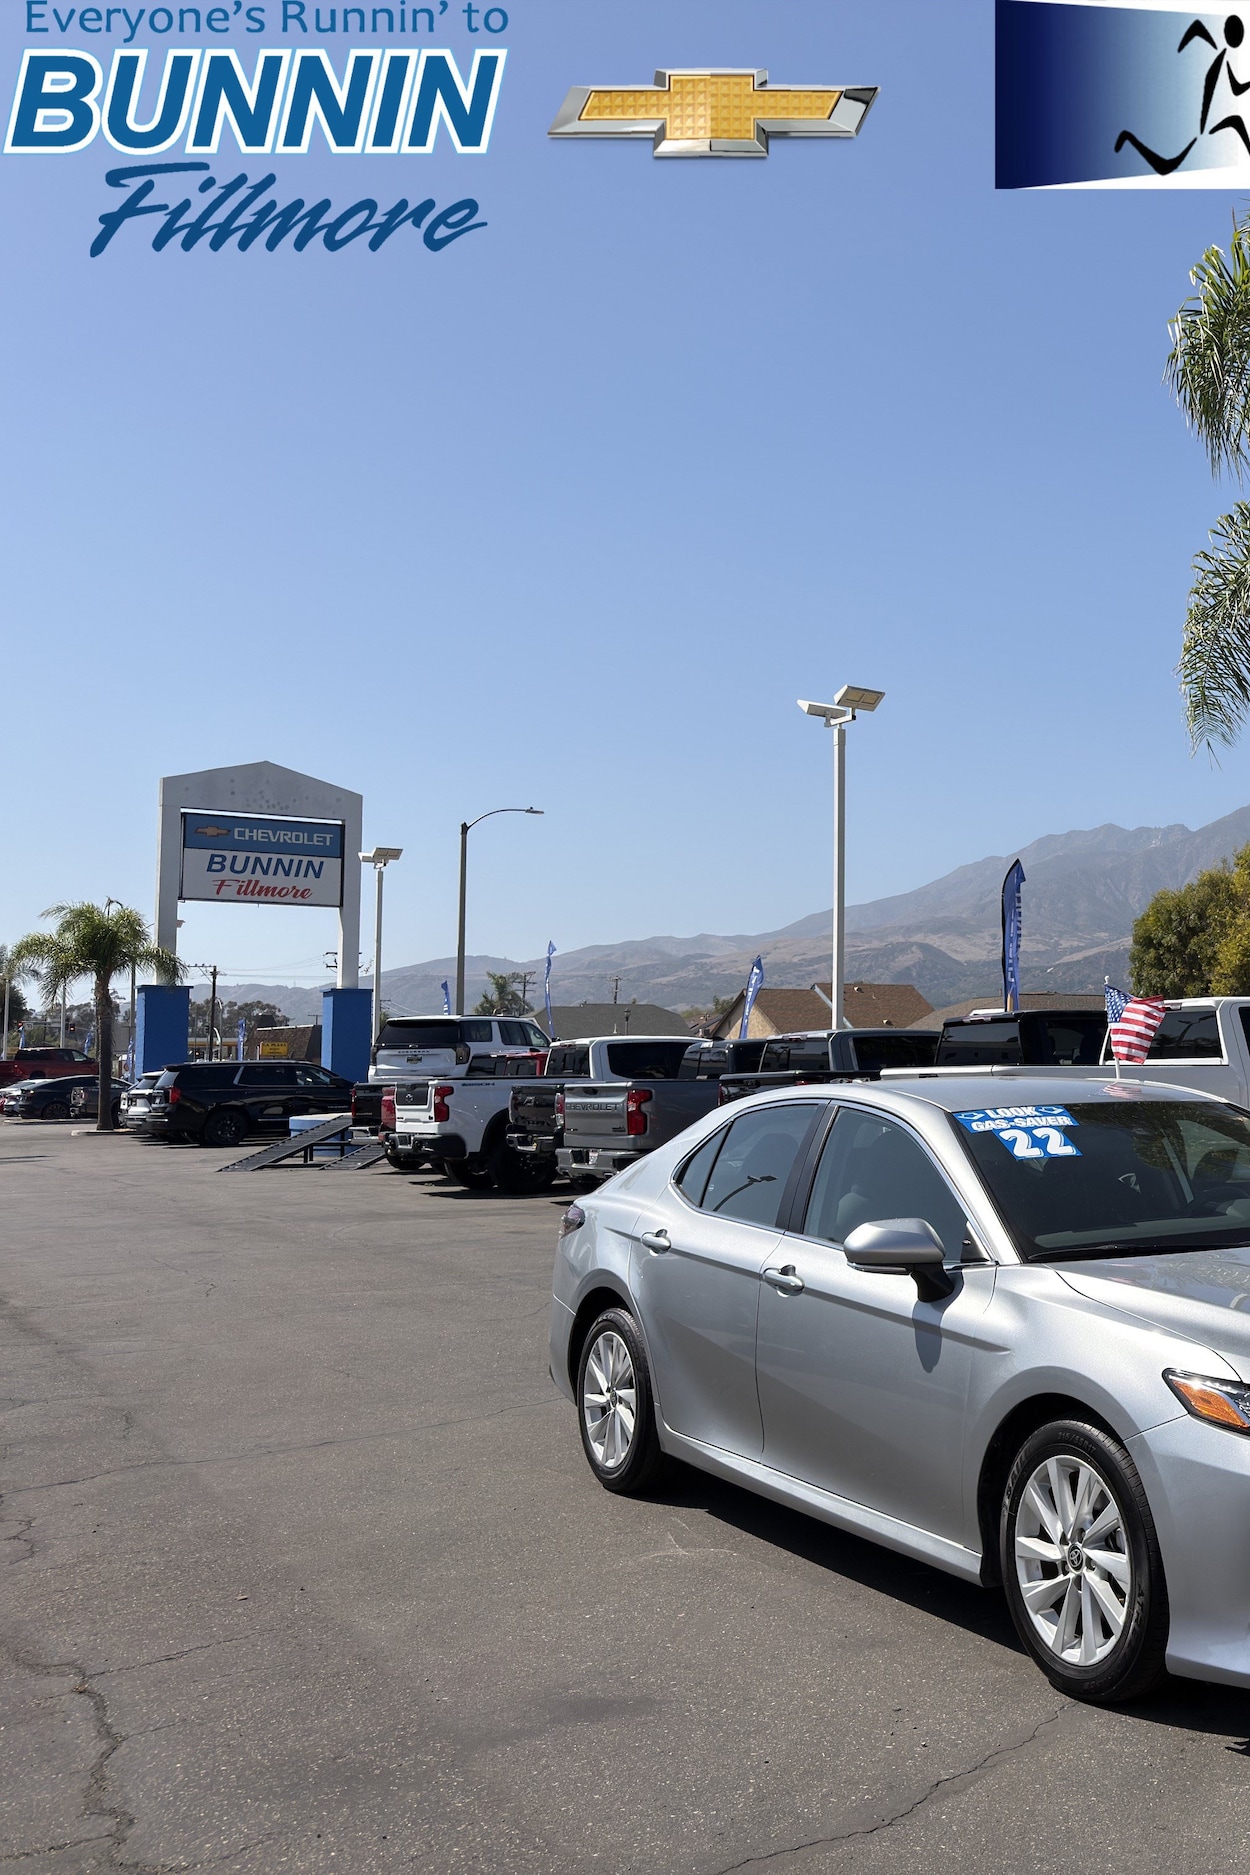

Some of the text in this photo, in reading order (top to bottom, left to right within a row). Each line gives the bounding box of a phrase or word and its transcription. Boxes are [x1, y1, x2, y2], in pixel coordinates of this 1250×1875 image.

[233, 827, 334, 846] CHEVROLET
[206, 853, 325, 879] BUNNIN
[212, 879, 313, 899] Fillmore
[565, 1103, 619, 1111] CHEVROLET
[984, 1105, 1042, 1119] LOOK
[971, 1115, 1075, 1132] GAS-SAVER
[998, 1127, 1079, 1158] 22
